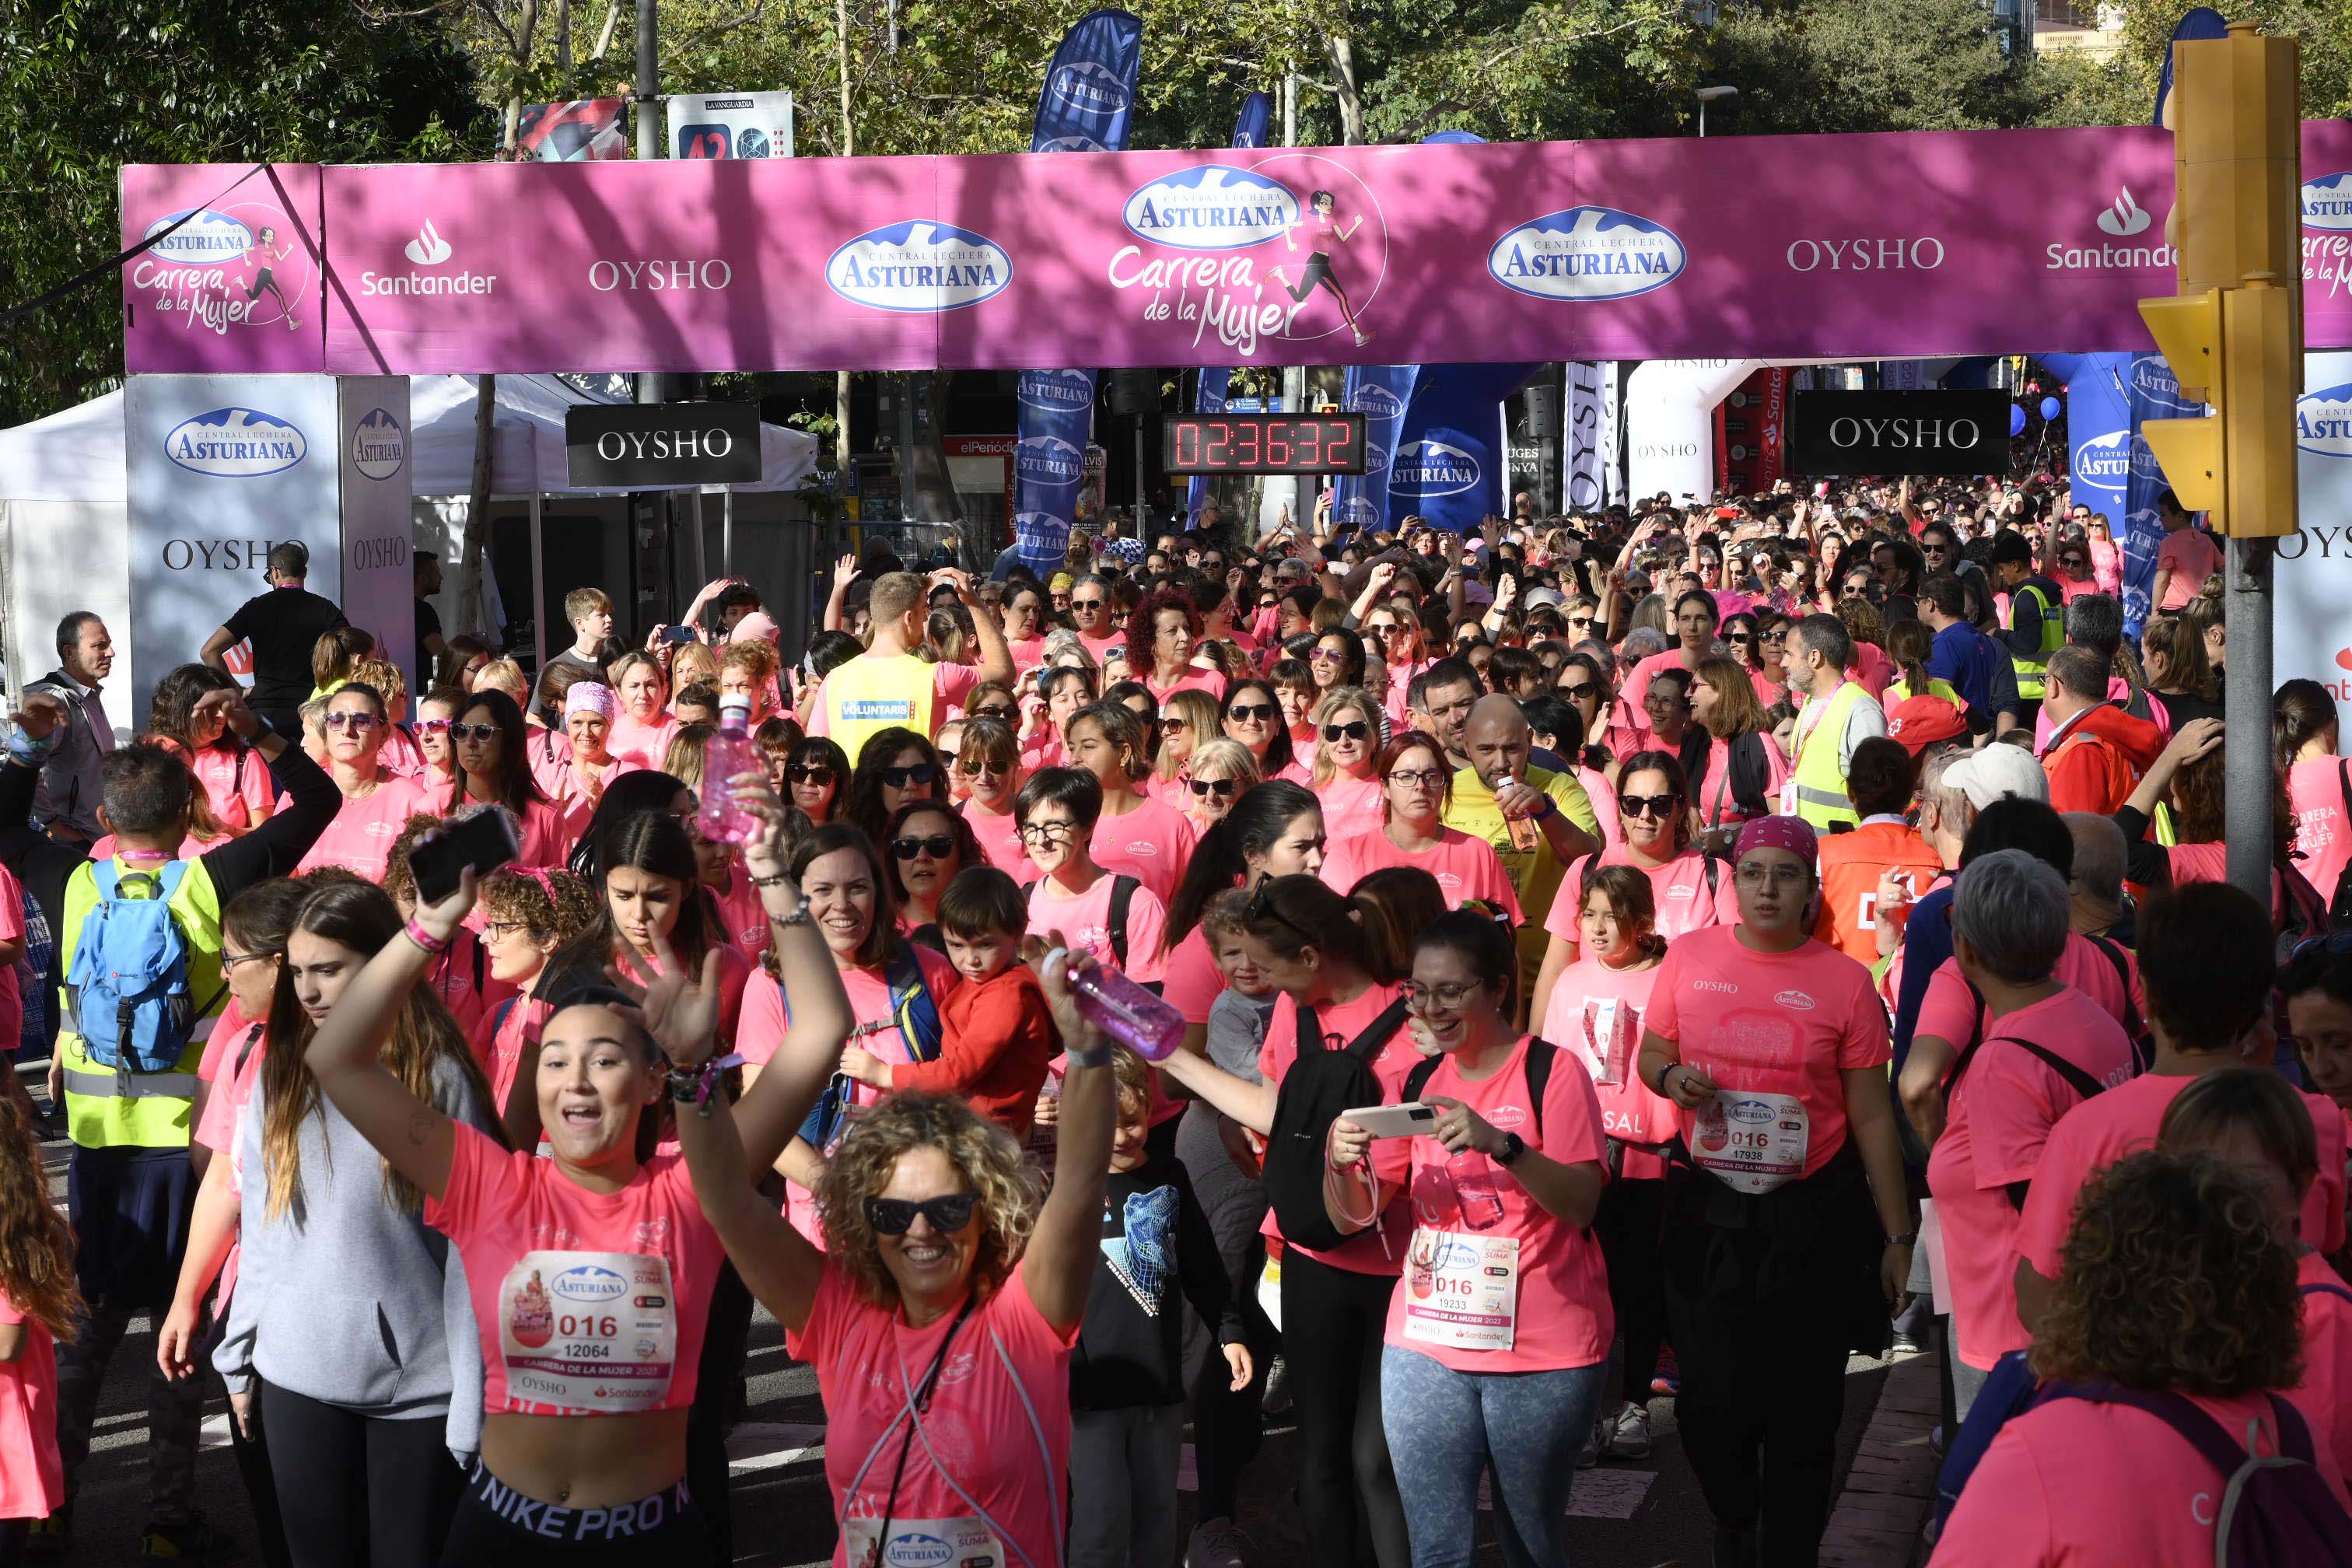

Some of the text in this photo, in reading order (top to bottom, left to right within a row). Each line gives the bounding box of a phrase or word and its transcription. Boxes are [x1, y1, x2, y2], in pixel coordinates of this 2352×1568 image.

[1055, 74, 1125, 107] ASTURIANA
[716, 100, 753, 108] VANGUARDIA
[1137, 198, 1285, 229] ASTURIANA
[152, 229, 245, 250] ASTURIANA
[1534, 238, 1664, 250] CENTRAL LECHERA
[868, 250, 993, 261] CENTRAL LECHERA
[1503, 243, 1671, 278] ASTURIANA
[1787, 236, 1945, 271] OYSHO
[134, 261, 225, 289] Carrera
[589, 259, 732, 291] OYSHO
[840, 254, 999, 289] ASTURIANA
[1108, 245, 1253, 289] Carrera
[2319, 258, 2333, 280] la
[361, 271, 497, 296] Santander
[156, 286, 259, 335] de la Mujer
[1144, 283, 1308, 356] de la Mujer
[1018, 374, 1089, 403] ASTURIANA
[597, 428, 733, 460] OYSHO
[1177, 422, 1351, 466] 02:36:32
[1570, 362, 1599, 511] OYSH
[1829, 417, 1979, 450] OYSHO
[176, 433, 297, 460] ASTURIANA
[356, 435, 401, 462] ASTURIANA
[1638, 442, 1697, 459] OYSHO
[1019, 457, 1080, 476] STURIANA
[1084, 457, 1102, 466] LVIS
[354, 536, 406, 571] OYSHO
[842, 705, 908, 715] VOLUNTARIS
[2314, 821, 2329, 834] LA
[2298, 832, 2333, 850] MUJER
[1693, 979, 1738, 995] OYSHO
[1603, 1110, 1643, 1134] SAL
[1733, 1108, 1773, 1120] ASTURIANA
[1731, 1132, 1769, 1147] 016
[1703, 1160, 1734, 1169] CARRERA
[1734, 1150, 1763, 1160] 17938
[1106, 1260, 1130, 1289] JURASSIC
[558, 1279, 622, 1294] ASTURIANA
[1437, 1277, 1472, 1296] 016
[1128, 1286, 1154, 1318] MONSTERS
[1439, 1298, 1467, 1310] 19233
[559, 1315, 618, 1337] 016
[1415, 1308, 1440, 1318] CARRERA
[1458, 1314, 1483, 1323] MUJER
[1465, 1331, 1504, 1341] Santander
[565, 1344, 610, 1358] 12064
[523, 1359, 659, 1376] CARRERA DE LA MUJER 2023
[522, 1376, 567, 1395] OYSHO
[480, 1473, 572, 1539] NIKE
[575, 1495, 664, 1542] PRO
[891, 1545, 947, 1560] ASTURIANA
[957, 1536, 989, 1548] SUMA
